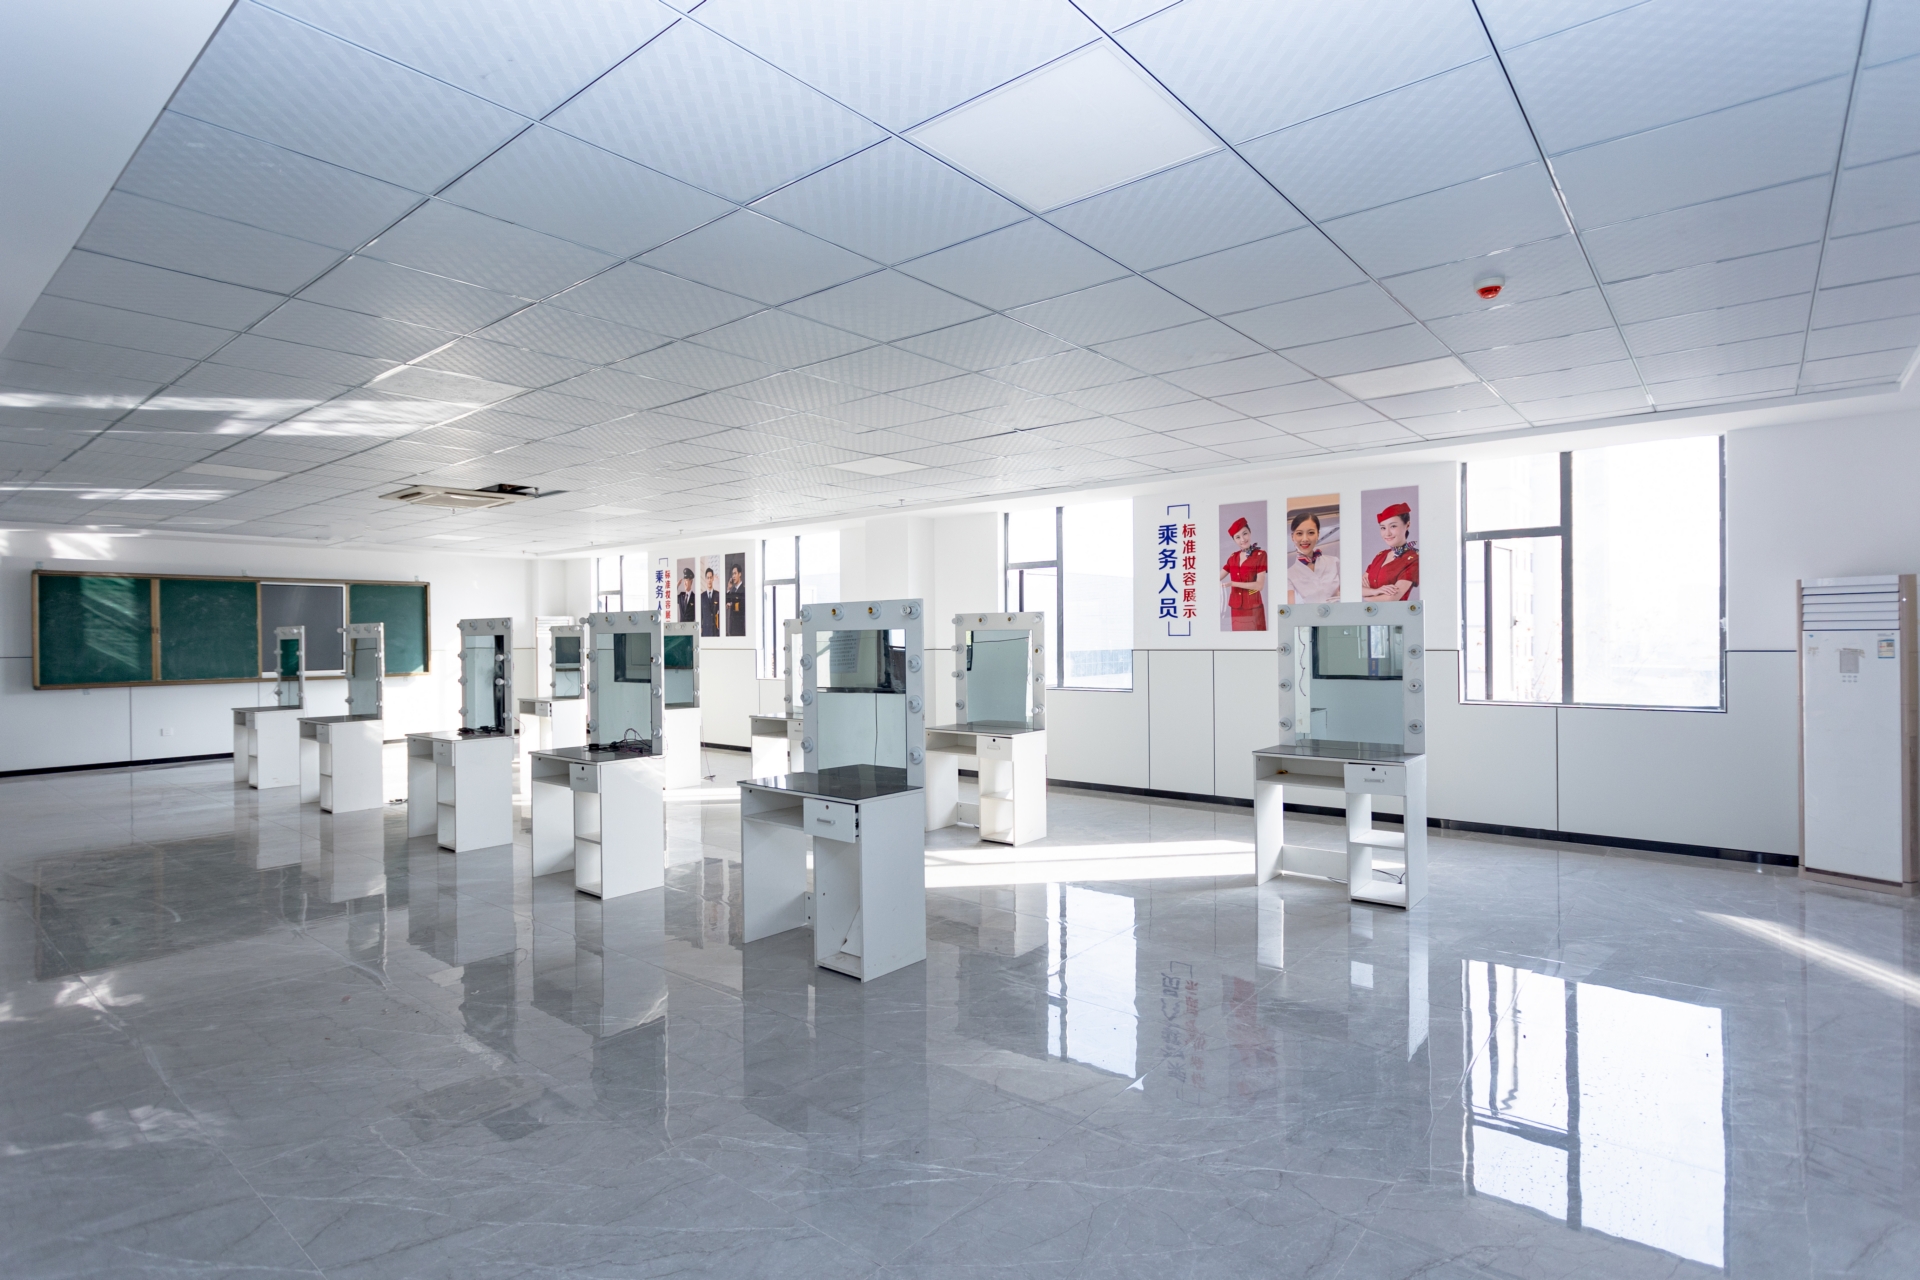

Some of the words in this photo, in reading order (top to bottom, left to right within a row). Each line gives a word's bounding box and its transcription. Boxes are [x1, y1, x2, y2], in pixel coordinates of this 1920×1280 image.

[1158, 523, 1179, 619] 乘务人员
[1181, 523, 1197, 619] 标准妆容展示
